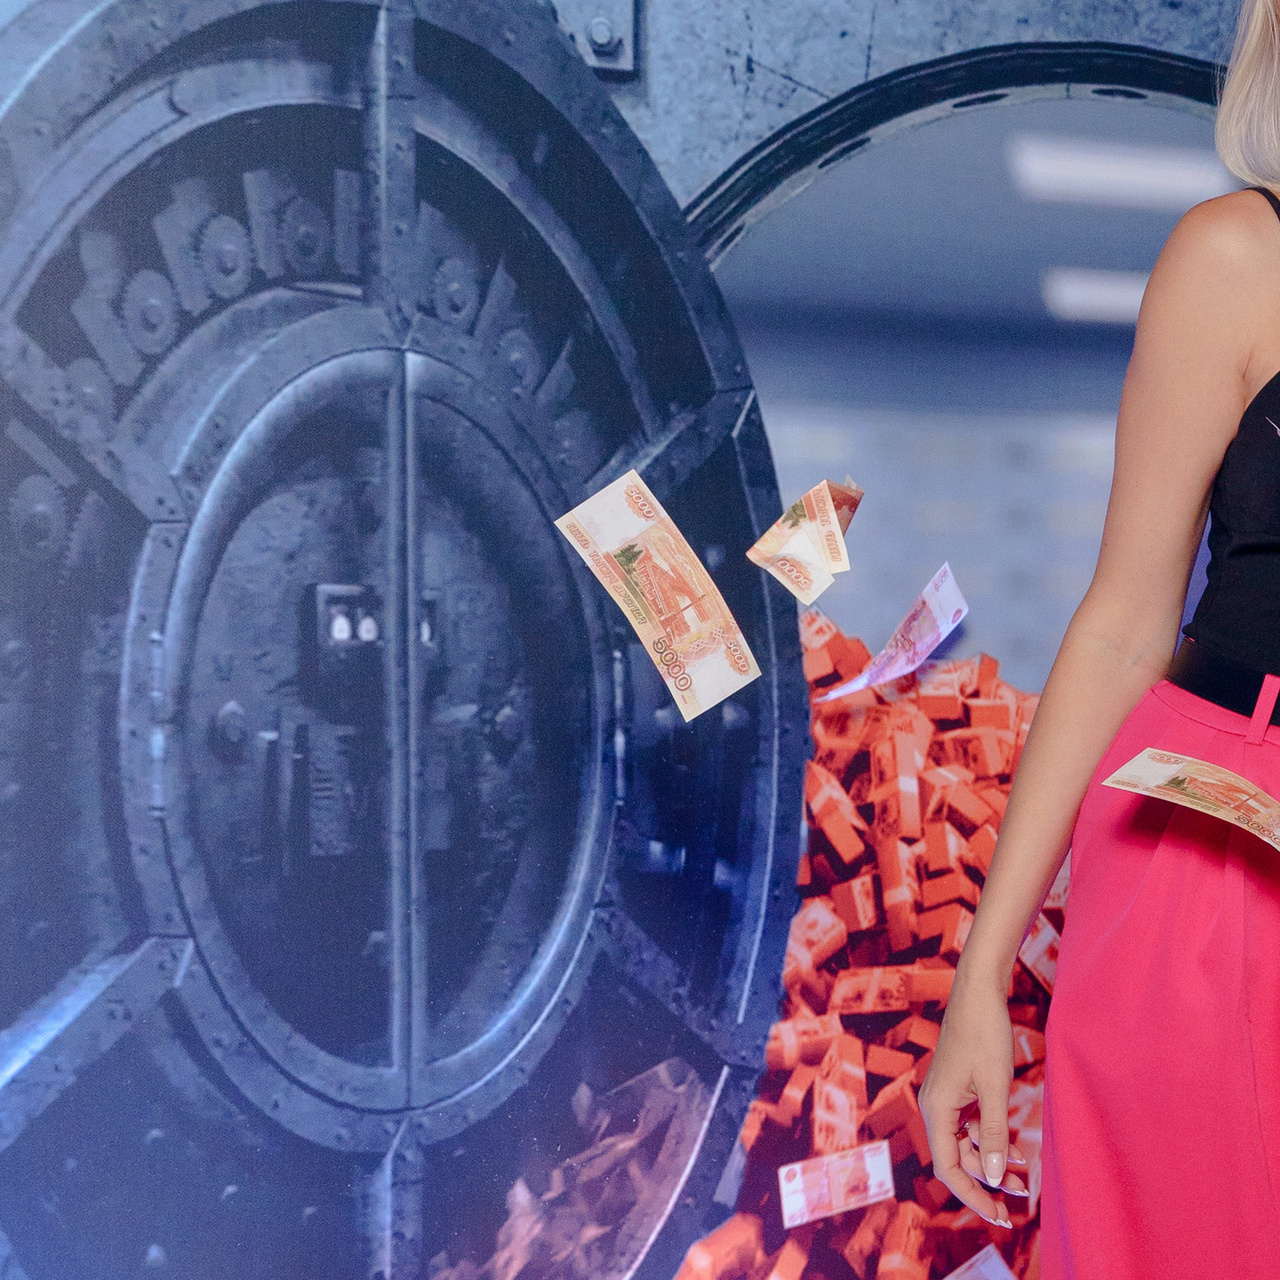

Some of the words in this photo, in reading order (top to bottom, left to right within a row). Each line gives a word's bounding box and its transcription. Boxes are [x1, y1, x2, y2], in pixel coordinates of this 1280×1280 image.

[627, 488, 655, 520] 5000
[776, 558, 812, 590] 5000
[652, 636, 693, 693] 5000
[726, 639, 749, 672] 5000
